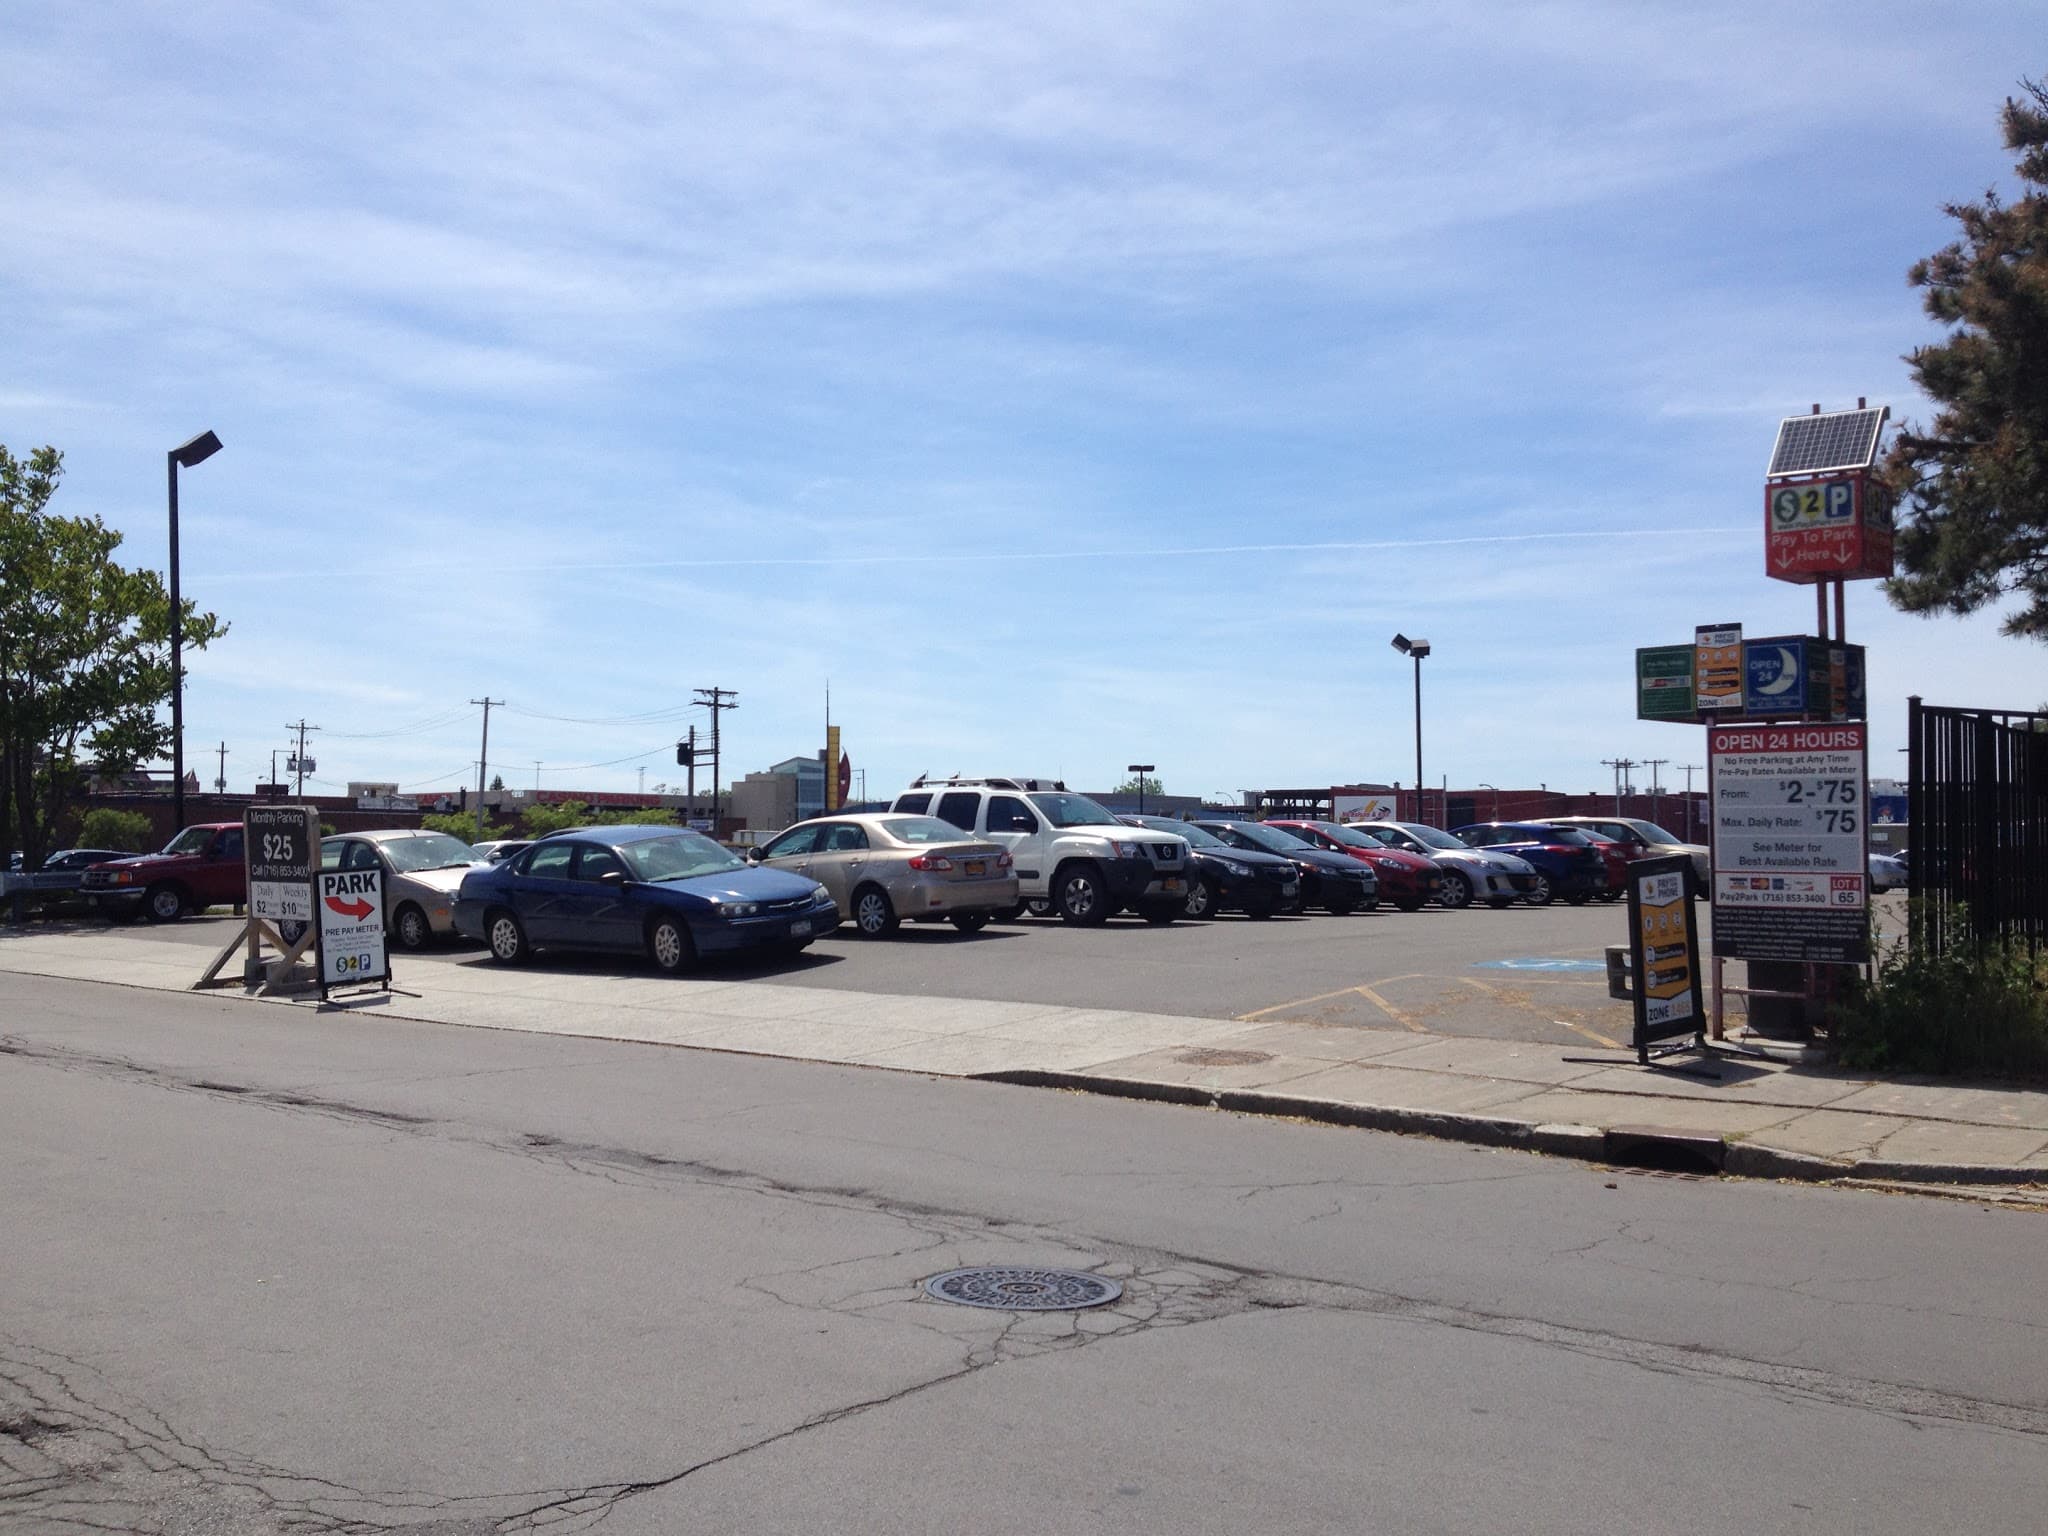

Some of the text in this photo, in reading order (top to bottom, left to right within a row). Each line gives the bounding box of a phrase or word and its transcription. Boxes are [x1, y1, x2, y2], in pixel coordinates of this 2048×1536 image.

[1772, 528, 1856, 547] Pay To Park
[1797, 549, 1830, 561] Here
[1750, 660, 1781, 670] OPEN
[1758, 671, 1773, 682] 24
[1715, 731, 1859, 751] OPEN 24 HOURS
[1724, 754, 1849, 766] No Free Parking at Any Time
[1718, 768, 1749, 777] Pre-Pay
[1752, 767, 1775, 775] Rates
[1776, 766, 1816, 775] Available
[1829, 766, 1857, 774] Meter
[1720, 789, 1750, 799] From:
[250, 811, 304, 827] Monthly Parking
[1720, 809, 1857, 833] Max. Daily Rate: $75
[263, 832, 293, 862] $25
[1753, 842, 1822, 852] See Meter for
[1739, 856, 1838, 867] Best Available Rate
[251, 864, 308, 878] Call (716) 853-3400
[324, 872, 377, 896] PARK
[1832, 879, 1850, 889] LOT
[256, 884, 307, 900] Daily Weekly
[1762, 892, 1784, 903] (716)
[1838, 892, 1855, 903] 65
[256, 900, 266, 913] $2
[281, 901, 297, 915] $10
[325, 923, 380, 936] PRE PAY METER
[1648, 1005, 1670, 1021] ZONE
